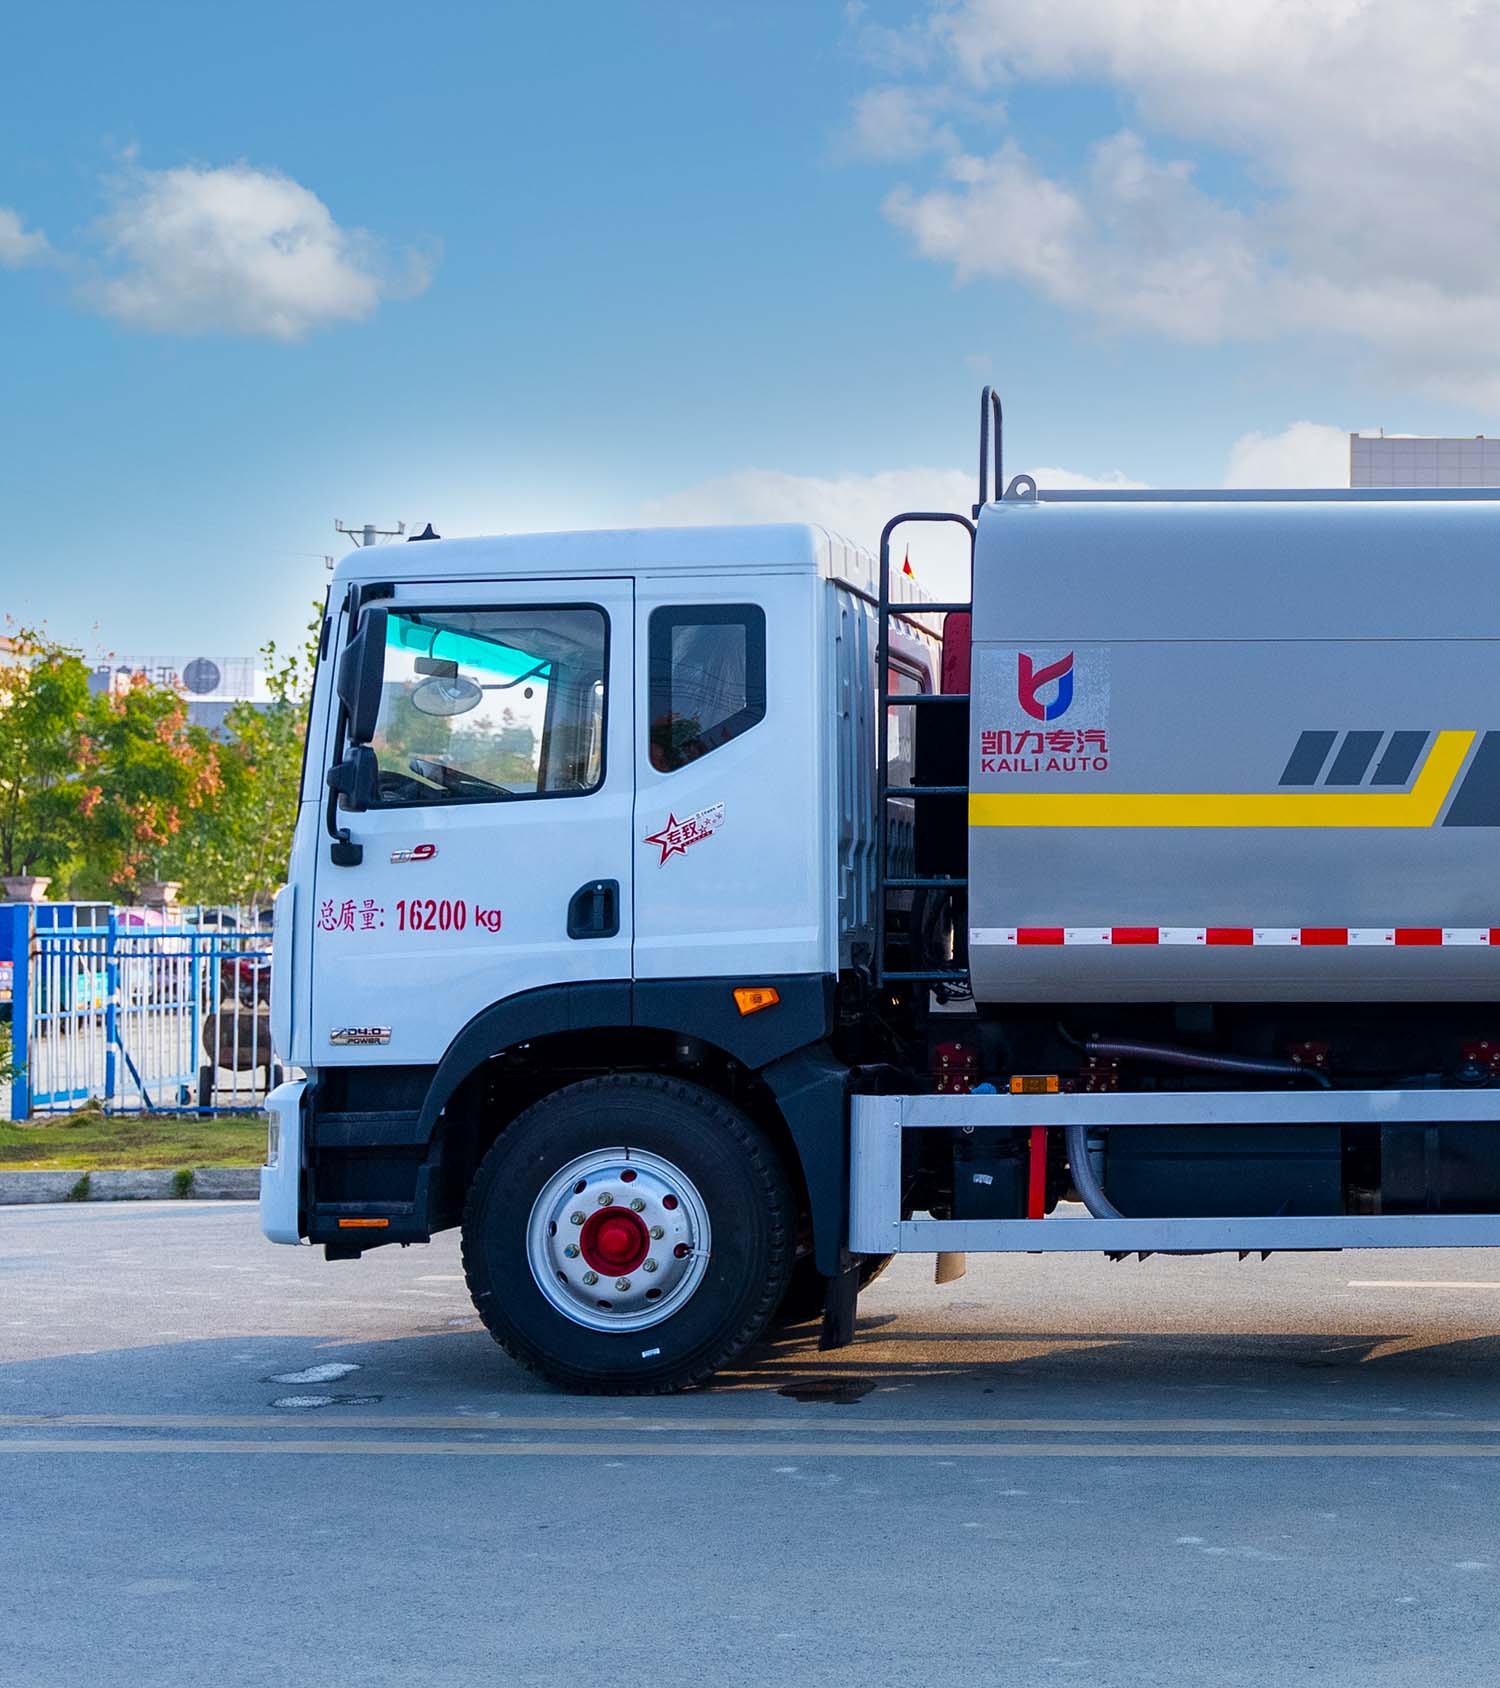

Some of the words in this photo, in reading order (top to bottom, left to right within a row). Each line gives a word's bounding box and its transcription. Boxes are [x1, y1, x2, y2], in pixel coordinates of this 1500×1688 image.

[981, 729, 1108, 755] 凯力专汽
[981, 758, 1039, 773] KAILI
[1046, 757, 1108, 772] AUTO
[396, 900, 467, 931] 16200
[475, 905, 502, 933] kg
[347, 1037, 382, 1045] POWER
